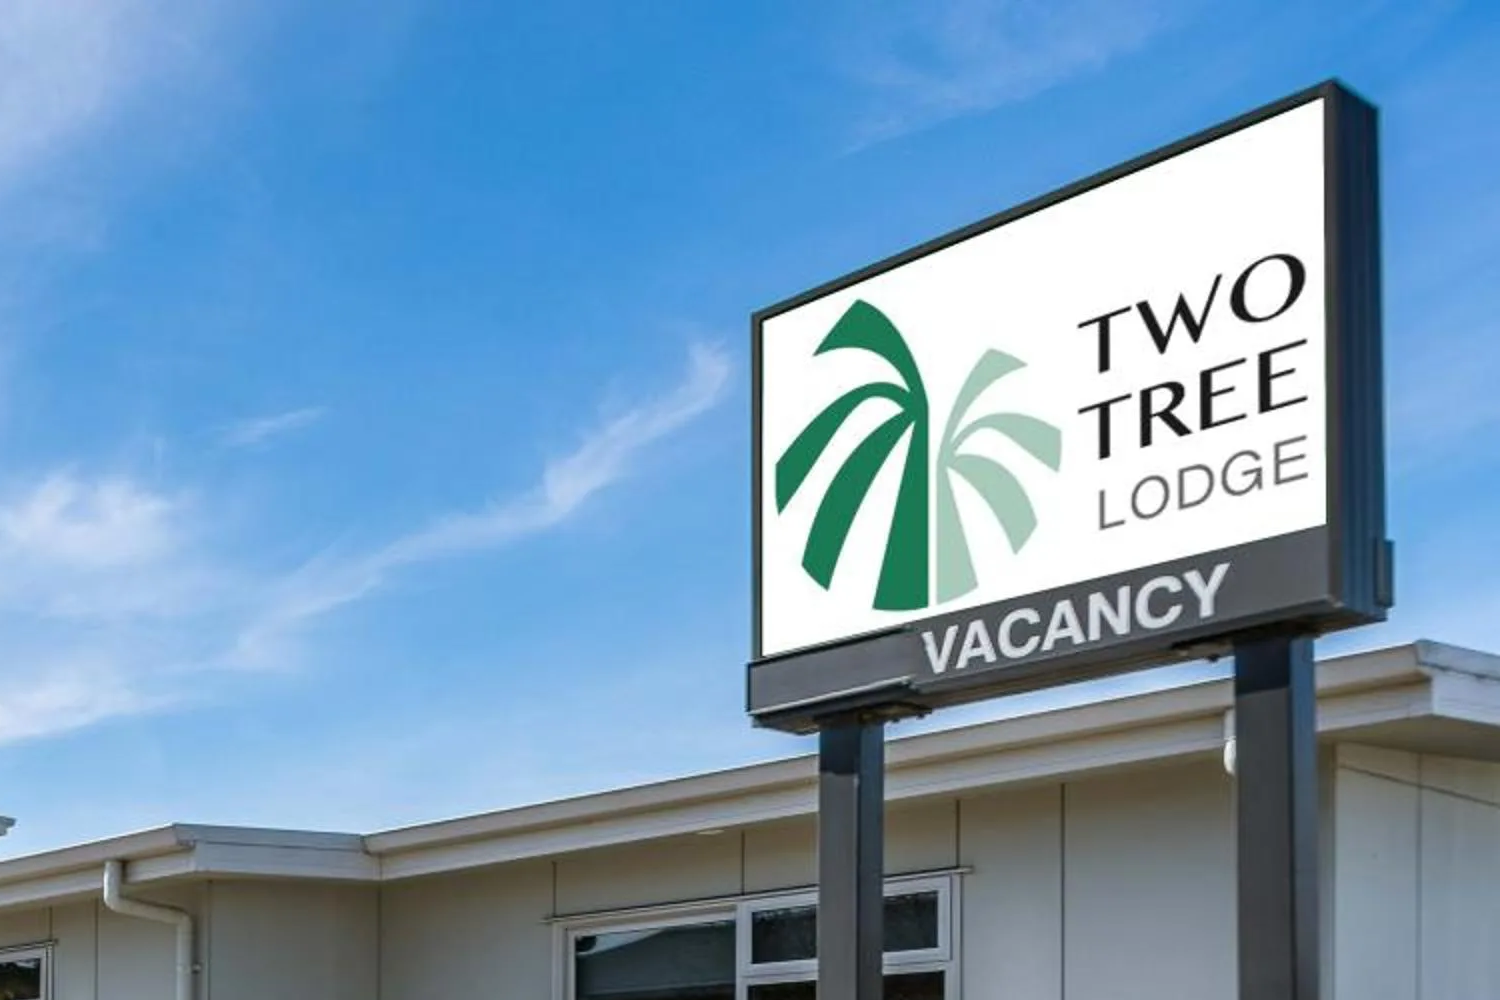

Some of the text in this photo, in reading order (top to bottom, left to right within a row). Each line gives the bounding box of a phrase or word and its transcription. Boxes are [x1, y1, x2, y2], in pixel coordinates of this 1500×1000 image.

[1077, 253, 1307, 374] TWO
[1077, 339, 1308, 461] TREE
[1098, 435, 1308, 532] LODGE
[923, 563, 1230, 675] VACANCY
